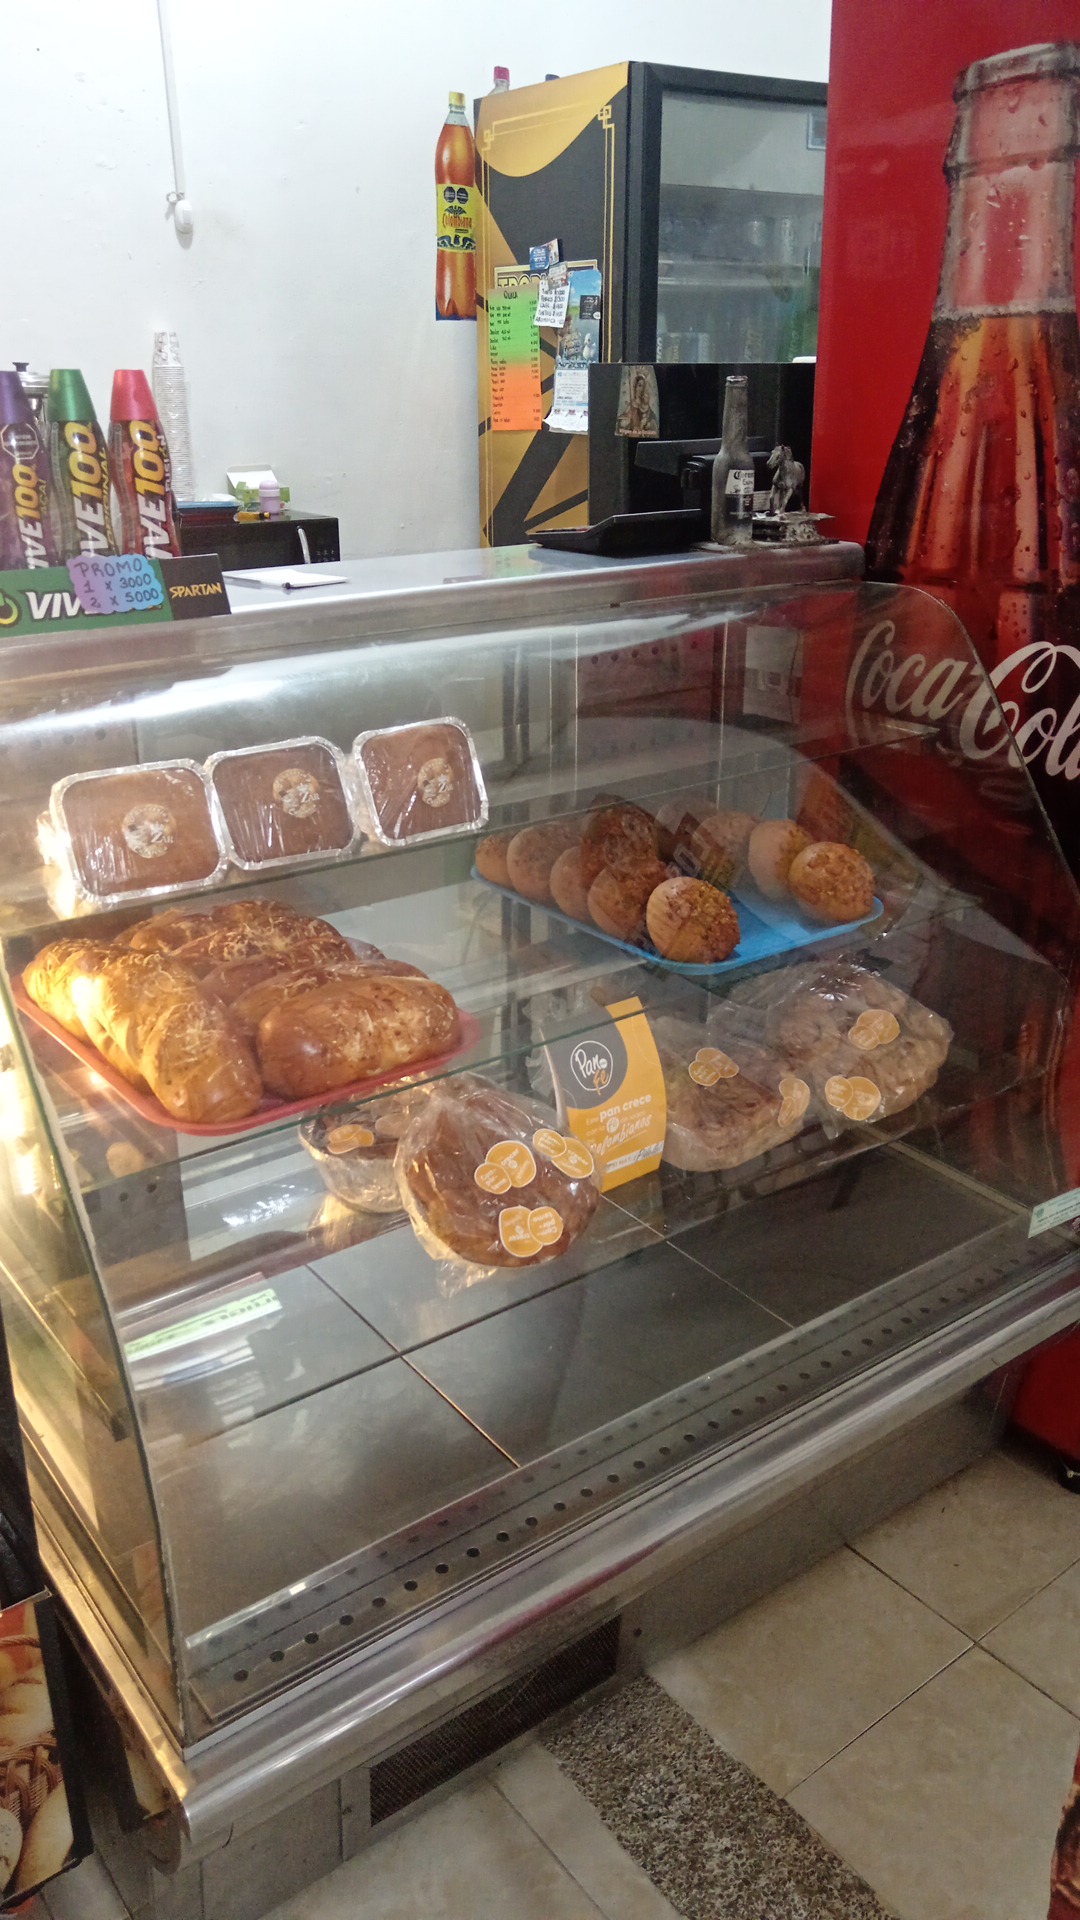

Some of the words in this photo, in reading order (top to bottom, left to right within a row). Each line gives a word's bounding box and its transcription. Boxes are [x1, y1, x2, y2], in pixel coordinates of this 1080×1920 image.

[129, 420, 173, 559] IVE100
[12, 464, 49, 569] IVE100
[74, 557, 142, 578] PROMO
[83, 581, 95, 593] 1
[119, 573, 151, 588] 3000
[169, 582, 223, 599] SPARTAN
[90, 597, 102, 609] 2
[125, 588, 159, 603] 5000
[600, 1104, 621, 1122] pan
[622, 1094, 652, 1111] crece
